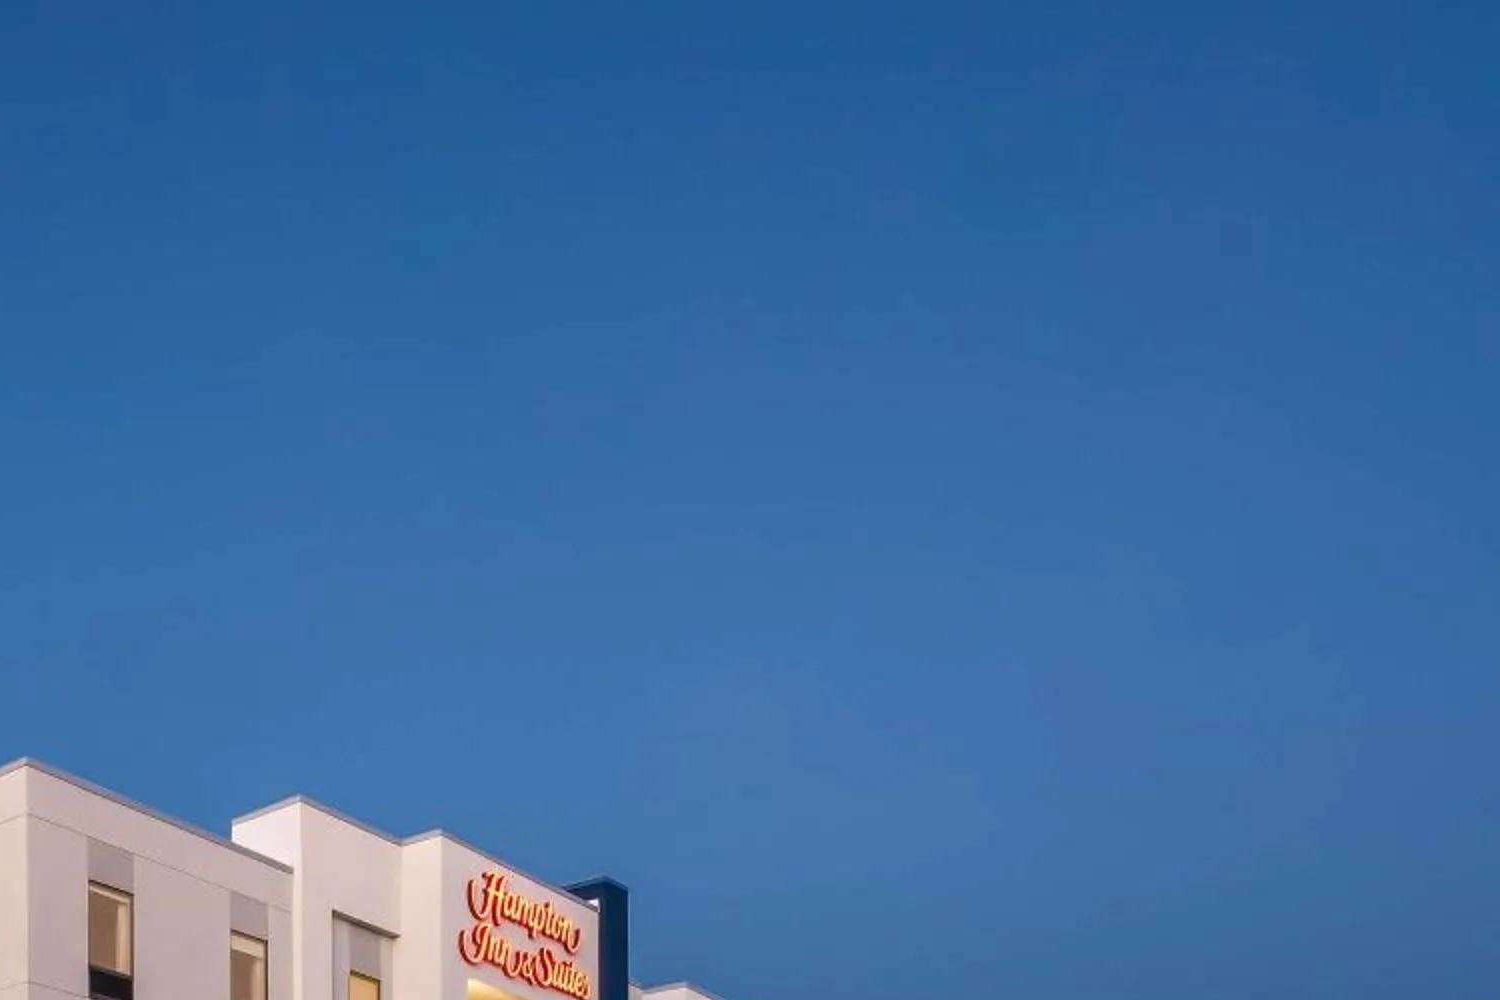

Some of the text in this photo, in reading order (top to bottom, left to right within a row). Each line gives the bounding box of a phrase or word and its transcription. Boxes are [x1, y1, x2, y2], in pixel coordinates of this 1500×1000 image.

[467, 872, 581, 953] Hampton
[458, 923, 522, 977] Inn
[534, 946, 592, 1000] Suites
